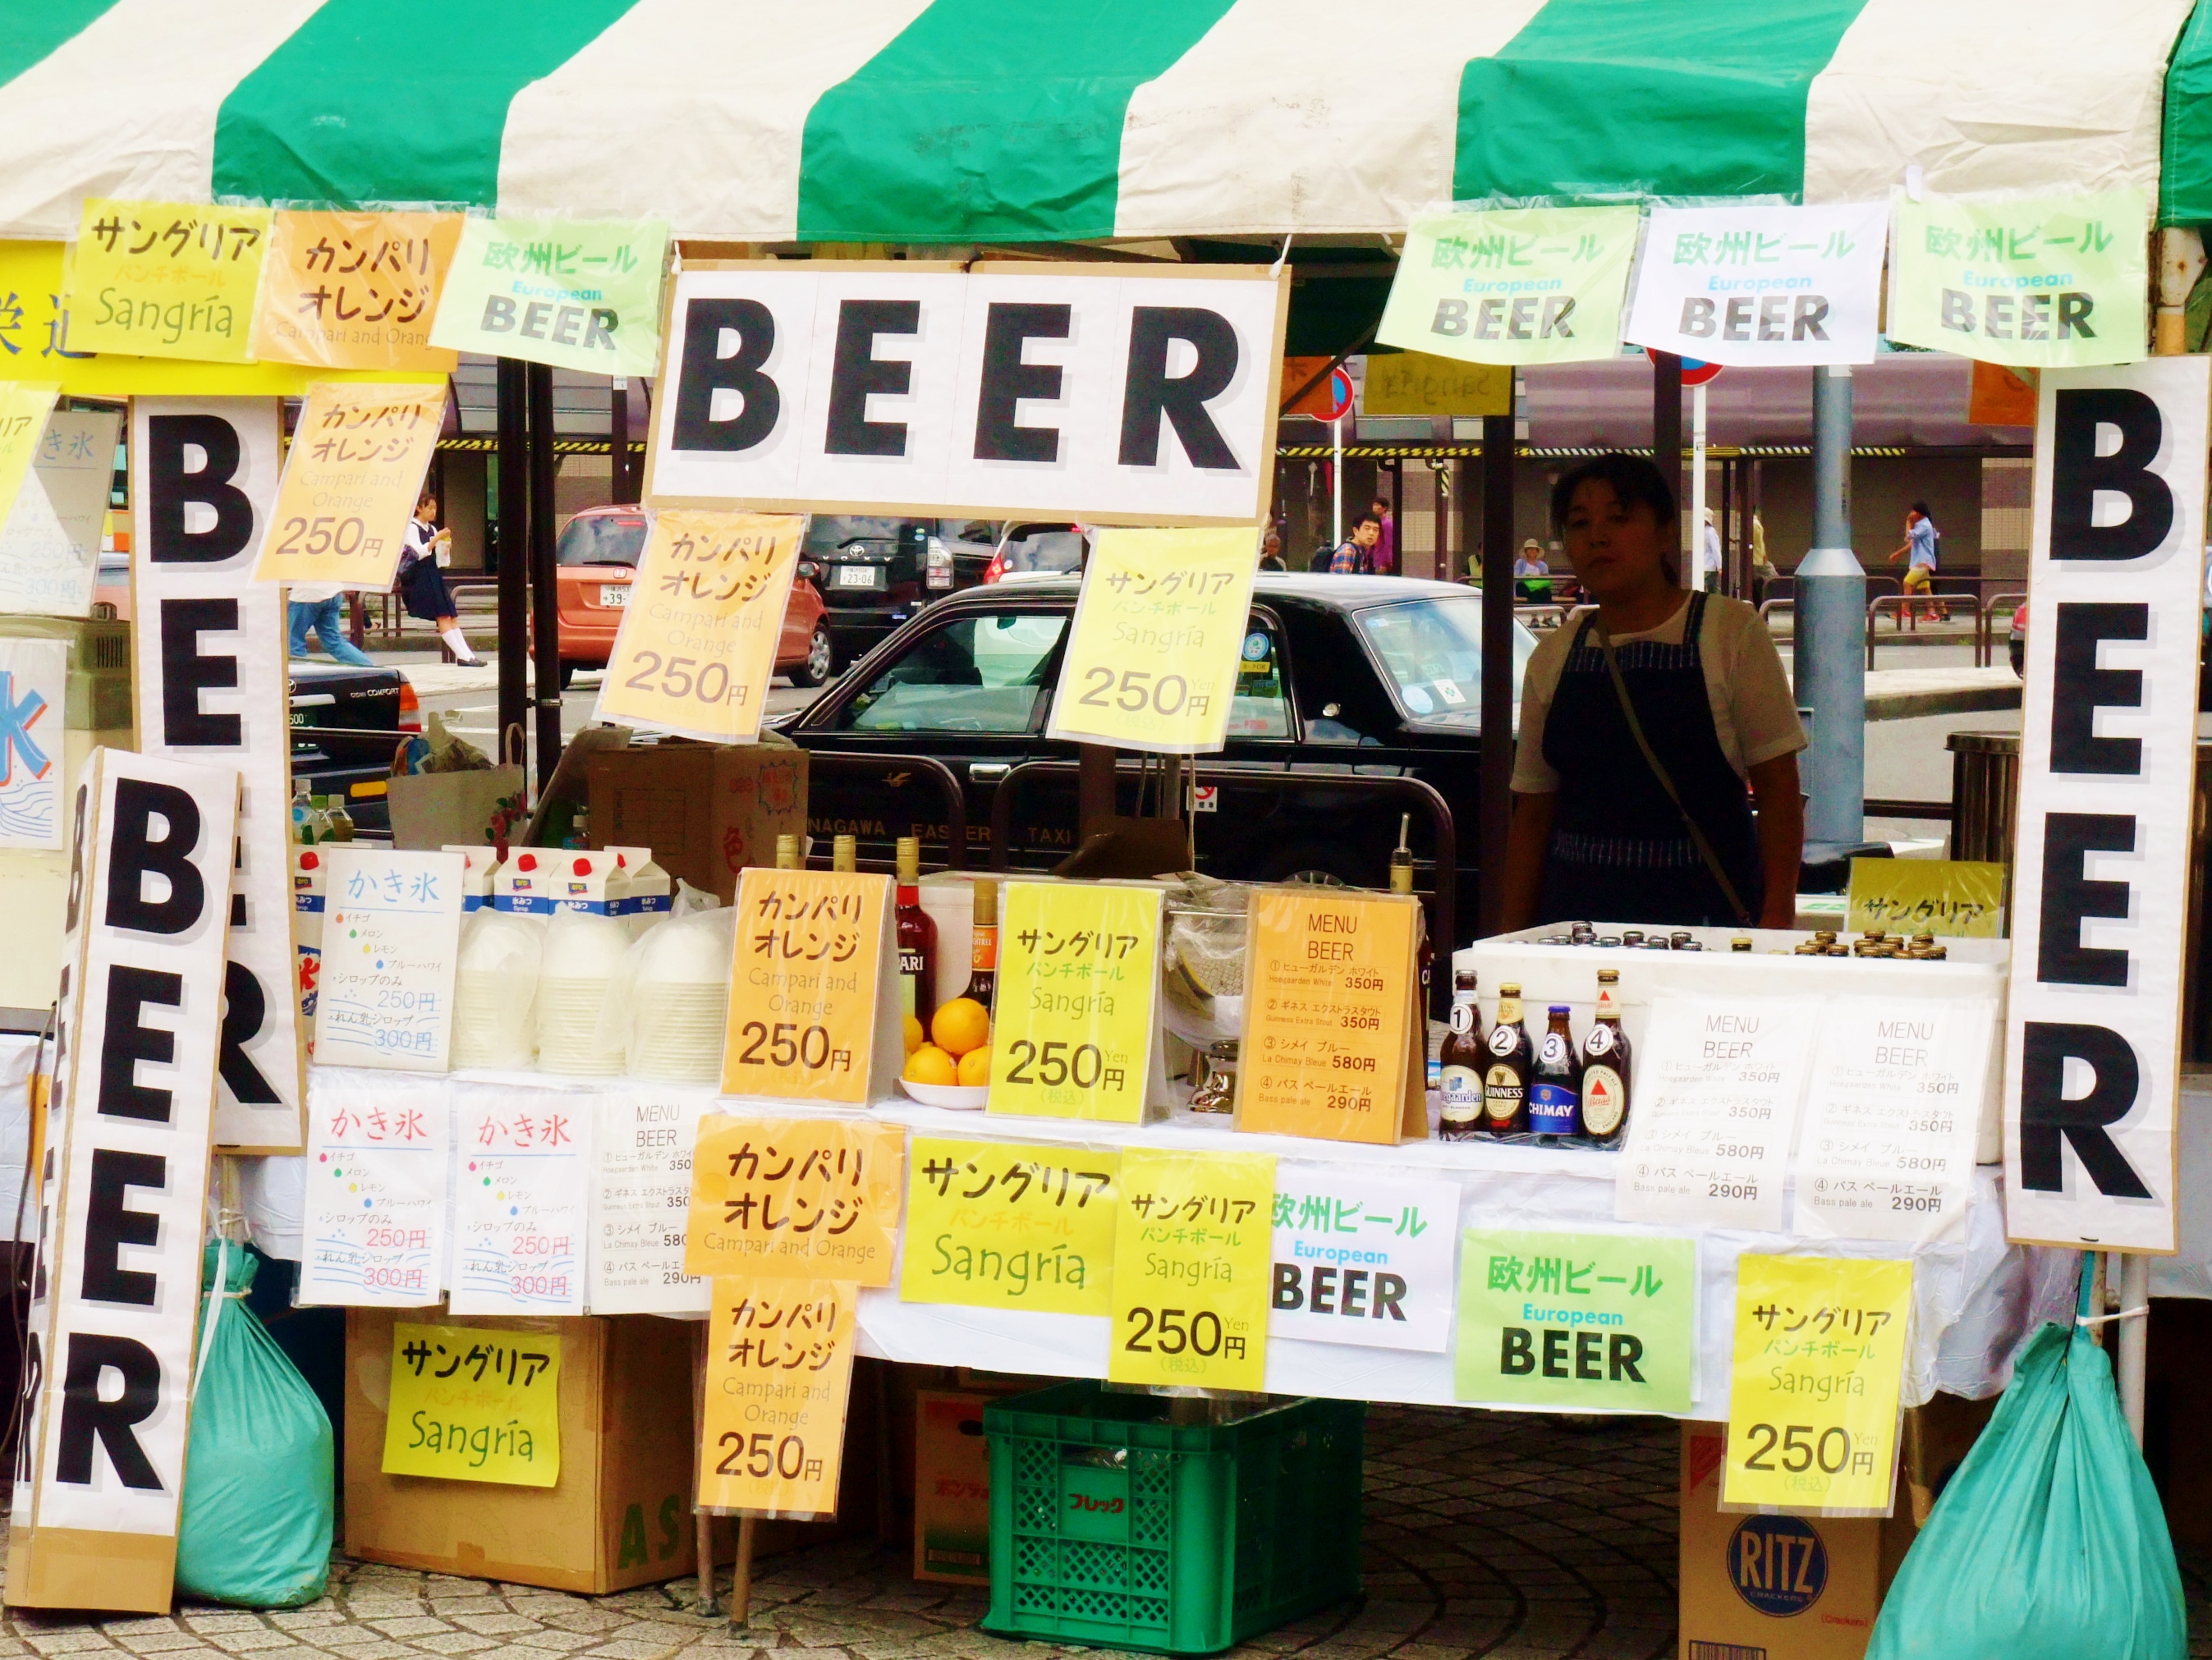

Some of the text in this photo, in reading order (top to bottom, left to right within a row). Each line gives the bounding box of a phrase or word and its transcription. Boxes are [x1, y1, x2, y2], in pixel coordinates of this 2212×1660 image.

[91, 216, 261, 261] サングリア
[1430, 232, 1605, 269] 欧州ビール
[1673, 229, 1856, 266] 欧州ビール
[1925, 220, 2114, 263] 欧州ビール
[306, 236, 429, 276] カンパリ
[482, 241, 638, 277] 欧州ビール
[512, 280, 603, 303] European
[1462, 277, 1563, 296] European
[1708, 275, 1812, 293] European
[1962, 270, 2074, 291] European
[95, 287, 233, 344] Sangría
[298, 285, 429, 323] オレンジ
[1941, 287, 2099, 341] BEER
[480, 294, 620, 351] BEER
[1430, 295, 1576, 340] BEER
[1678, 295, 1831, 342] BEER
[672, 298, 1242, 470] BEER
[323, 403, 421, 430] カンパリ
[44, 429, 94, 461] き氷
[311, 437, 415, 463] オレンジ
[300, 470, 402, 490] Campari and
[313, 492, 374, 513] Orange
[276, 516, 384, 558] 250円
[671, 532, 776, 565] カンパリ
[660, 570, 772, 602] オレンジ
[1105, 570, 1236, 596] サングリア
[649, 603, 764, 631] Campari and
[1112, 600, 1217, 617] パンチボール
[667, 630, 737, 658] Orange
[1112, 621, 1205, 653] Sangría
[625, 650, 748, 707] 250円
[1191, 678, 1215, 690] Yen
[367, 687, 399, 697] COMFORT
[1078, 667, 1210, 717] 250円
[2021, 388, 2174, 1199] BEER
[348, 869, 439, 903] かき氷
[345, 913, 371, 923] イチゴ
[759, 891, 862, 924] カンパリ
[1865, 897, 1984, 924] サングリア
[360, 929, 383, 938] メロン
[1308, 913, 1357, 934] MENU
[374, 945, 397, 955] レモン
[755, 929, 860, 962] オレンジ
[1017, 929, 1139, 959] サングリア
[1307, 941, 1355, 961] BEER
[388, 961, 442, 972] ブルーハワイ
[1026, 962, 1125, 981] パンチボール
[1283, 964, 1379, 977] ヒューガルデン ホワイト
[748, 967, 857, 993] Campari and
[1269, 975, 1384, 992] Hoegaarden White 350円
[378, 990, 435, 1011] 250円
[769, 994, 833, 1020] Orange
[1030, 987, 1115, 1020] Sangría
[1281, 1001, 1381, 1016] ギネス エクストラスタウト
[1265, 1015, 1380, 1030] Guinness Extra Stout 350円
[1453, 1009, 1462, 1028] 1
[1705, 1014, 1760, 1034] MENU
[1878, 1020, 1934, 1041] MENU
[374, 1029, 432, 1051] 300円
[739, 1021, 851, 1072] 250円
[1280, 1039, 1351, 1052] シメイ ブルー
[1494, 1031, 1509, 1051] 2
[1544, 1038, 1558, 1058] 3
[1590, 1030, 1603, 1049] 4
[1703, 1040, 1753, 1059] BEER
[1006, 1039, 1125, 1092] 250円
[1104, 1049, 1128, 1065] Yen
[1262, 1055, 1376, 1072] La Chimay Bleue 580円
[1875, 1046, 1928, 1067] BEER
[1277, 1079, 1372, 1096] バス ペールエール
[1485, 1086, 1523, 1098] GUINNESS
[636, 1104, 681, 1123] MENU
[1259, 1094, 1371, 1112] Bass pale ale 290円
[1529, 1102, 1574, 1117] CHIMAY
[56, 777, 204, 1490] BEER
[331, 1107, 428, 1141] かき氷
[479, 1113, 571, 1148] かき氷
[636, 1129, 677, 1148] BEER
[728, 1142, 863, 1186] カンパリ
[922, 1158, 1111, 1208] サングリア
[1709, 1183, 1758, 1200] 290円
[723, 1192, 863, 1235] オレンジ
[1131, 1194, 1256, 1224] サングリア
[1891, 1196, 1942, 1213] 290円
[950, 1208, 1074, 1236] パンチボール
[367, 1229, 425, 1249] 250円
[512, 1236, 569, 1255] 250円
[704, 1232, 875, 1264] Campari and Orange
[1140, 1227, 1241, 1246] パンチボール
[932, 1234, 1085, 1296] Sangría
[1294, 1240, 1388, 1265] European
[364, 1268, 422, 1288] 300円
[1145, 1253, 1232, 1287] Sangría
[1488, 1255, 1664, 1298] 欧州ビール
[510, 1276, 567, 1295] 300円
[1273, 1263, 1407, 1322] BEER
[732, 1298, 836, 1332] カンパリ
[1223, 1317, 1249, 1332] Yen
[1523, 1303, 1623, 1328] European
[1752, 1304, 1891, 1337] サングリア
[1125, 1306, 1246, 1360] 250円
[728, 1337, 835, 1371] オレンジ
[1501, 1327, 1646, 1383] BEER
[1764, 1339, 1875, 1360] パンチボール
[402, 1340, 550, 1387] サングリア
[723, 1377, 831, 1402] Campari and
[1769, 1366, 1865, 1402] Sangría
[745, 1405, 809, 1430] Orange
[409, 1410, 534, 1467] Sangría
[1744, 1424, 1874, 1476] 250円
[1854, 1432, 1878, 1446] Yen
[715, 1431, 823, 1482] 250円
[1740, 1530, 1816, 1594] RITZ
